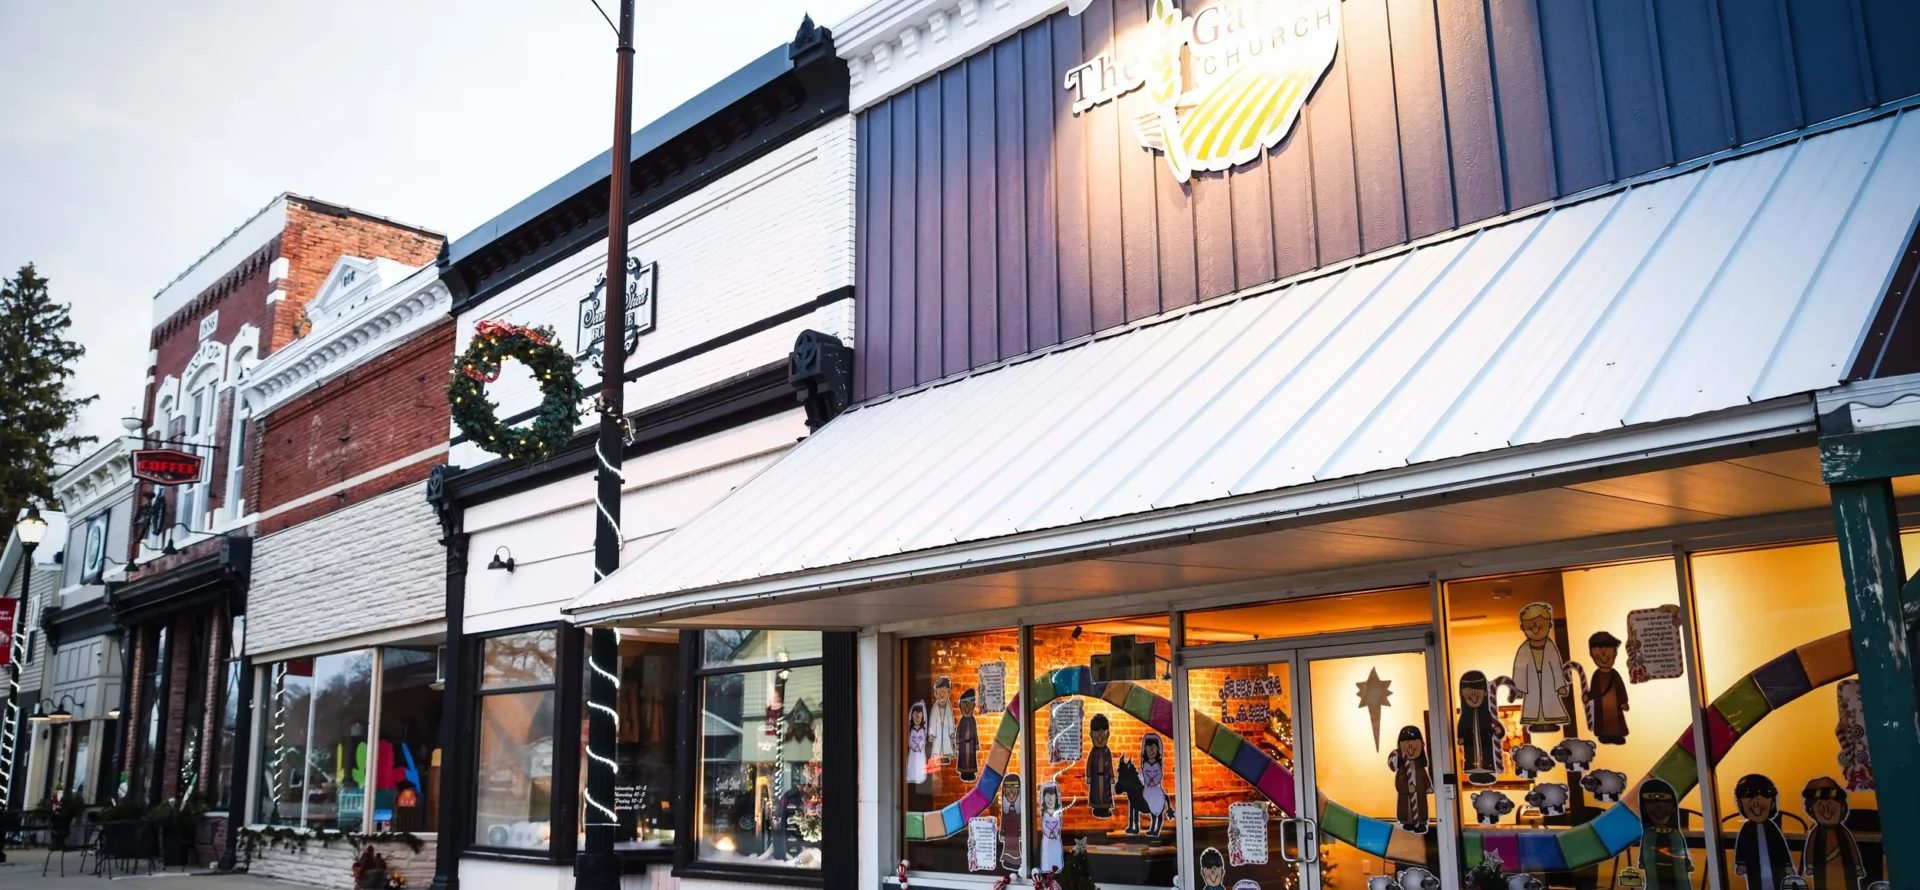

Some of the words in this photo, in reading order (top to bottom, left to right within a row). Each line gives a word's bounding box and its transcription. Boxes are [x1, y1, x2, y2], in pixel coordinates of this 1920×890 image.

[1203, 6, 1333, 76] CHURCH
[1068, 55, 1141, 102] The
[138, 460, 196, 474] COFFEE
[1219, 676, 1282, 699] JUDAH
[1221, 700, 1270, 723] LAND
